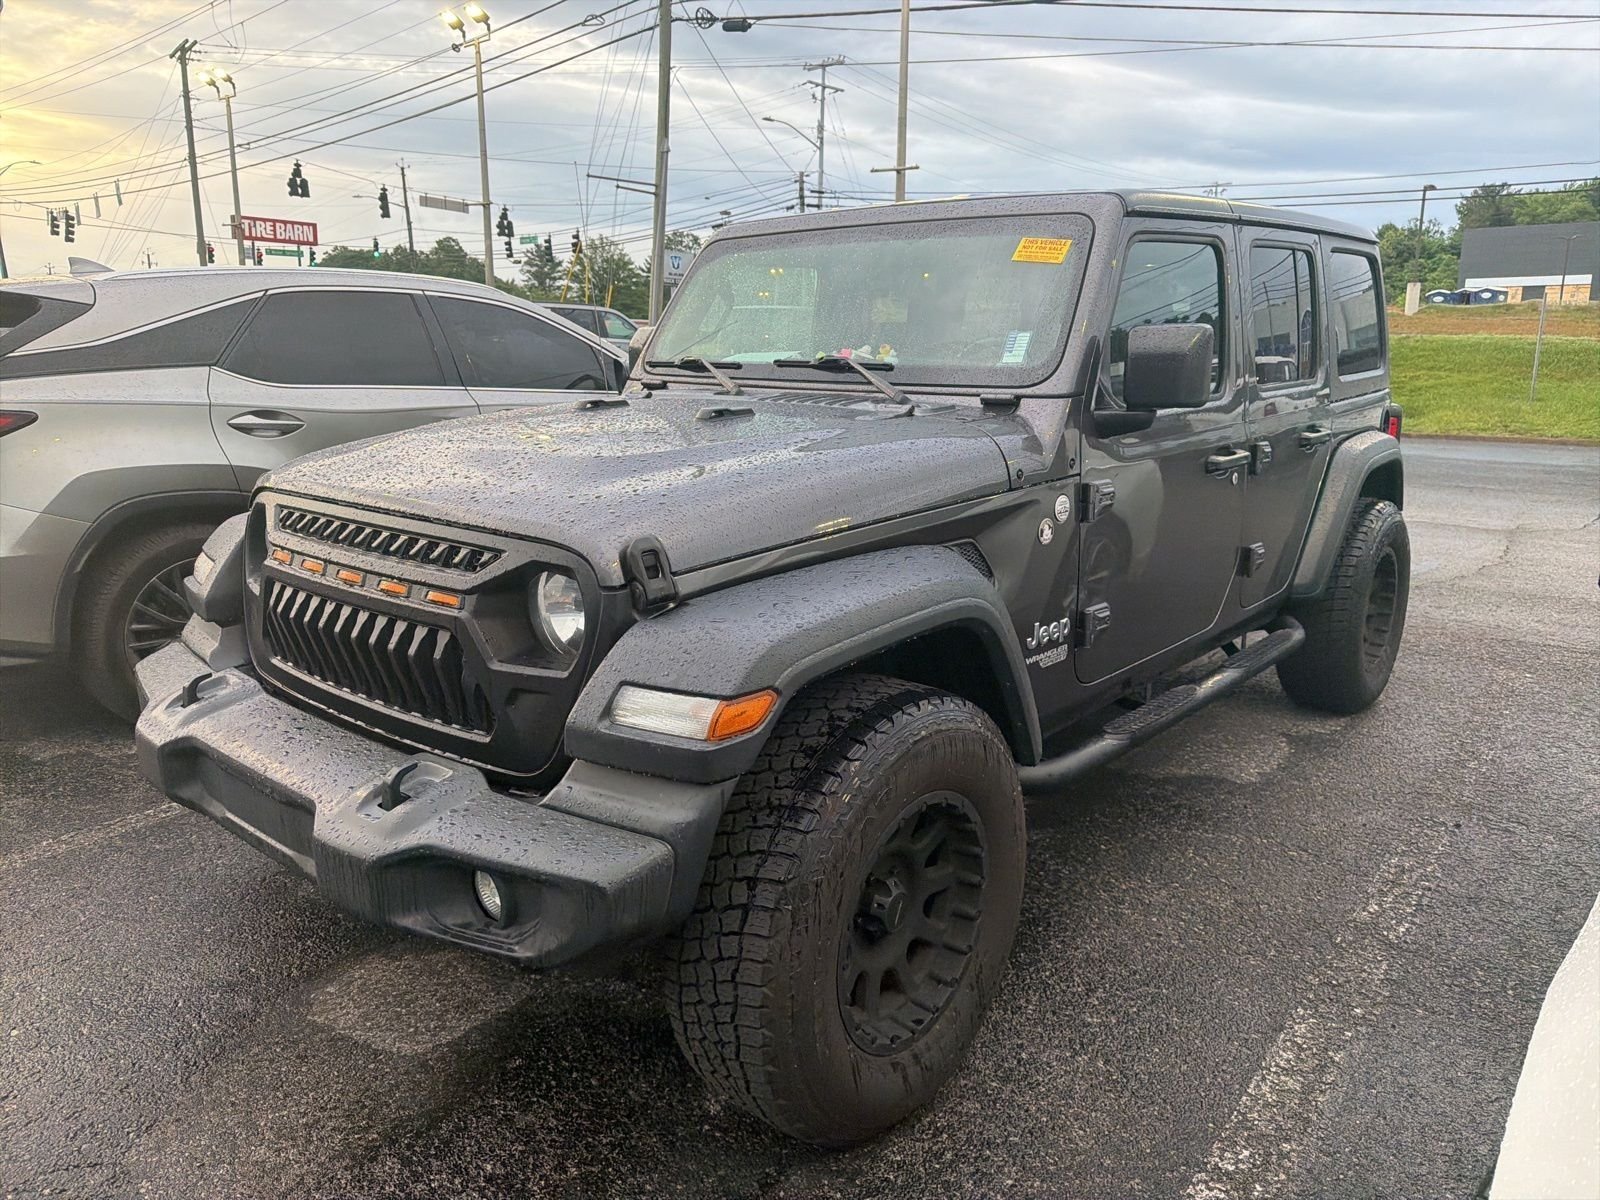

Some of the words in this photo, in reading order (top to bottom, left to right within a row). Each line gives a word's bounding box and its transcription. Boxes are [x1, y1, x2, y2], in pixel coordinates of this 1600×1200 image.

[275, 222, 314, 242] BARN
[1026, 617, 1070, 650] Jeep
[1025, 644, 1068, 665] WRANGLER
